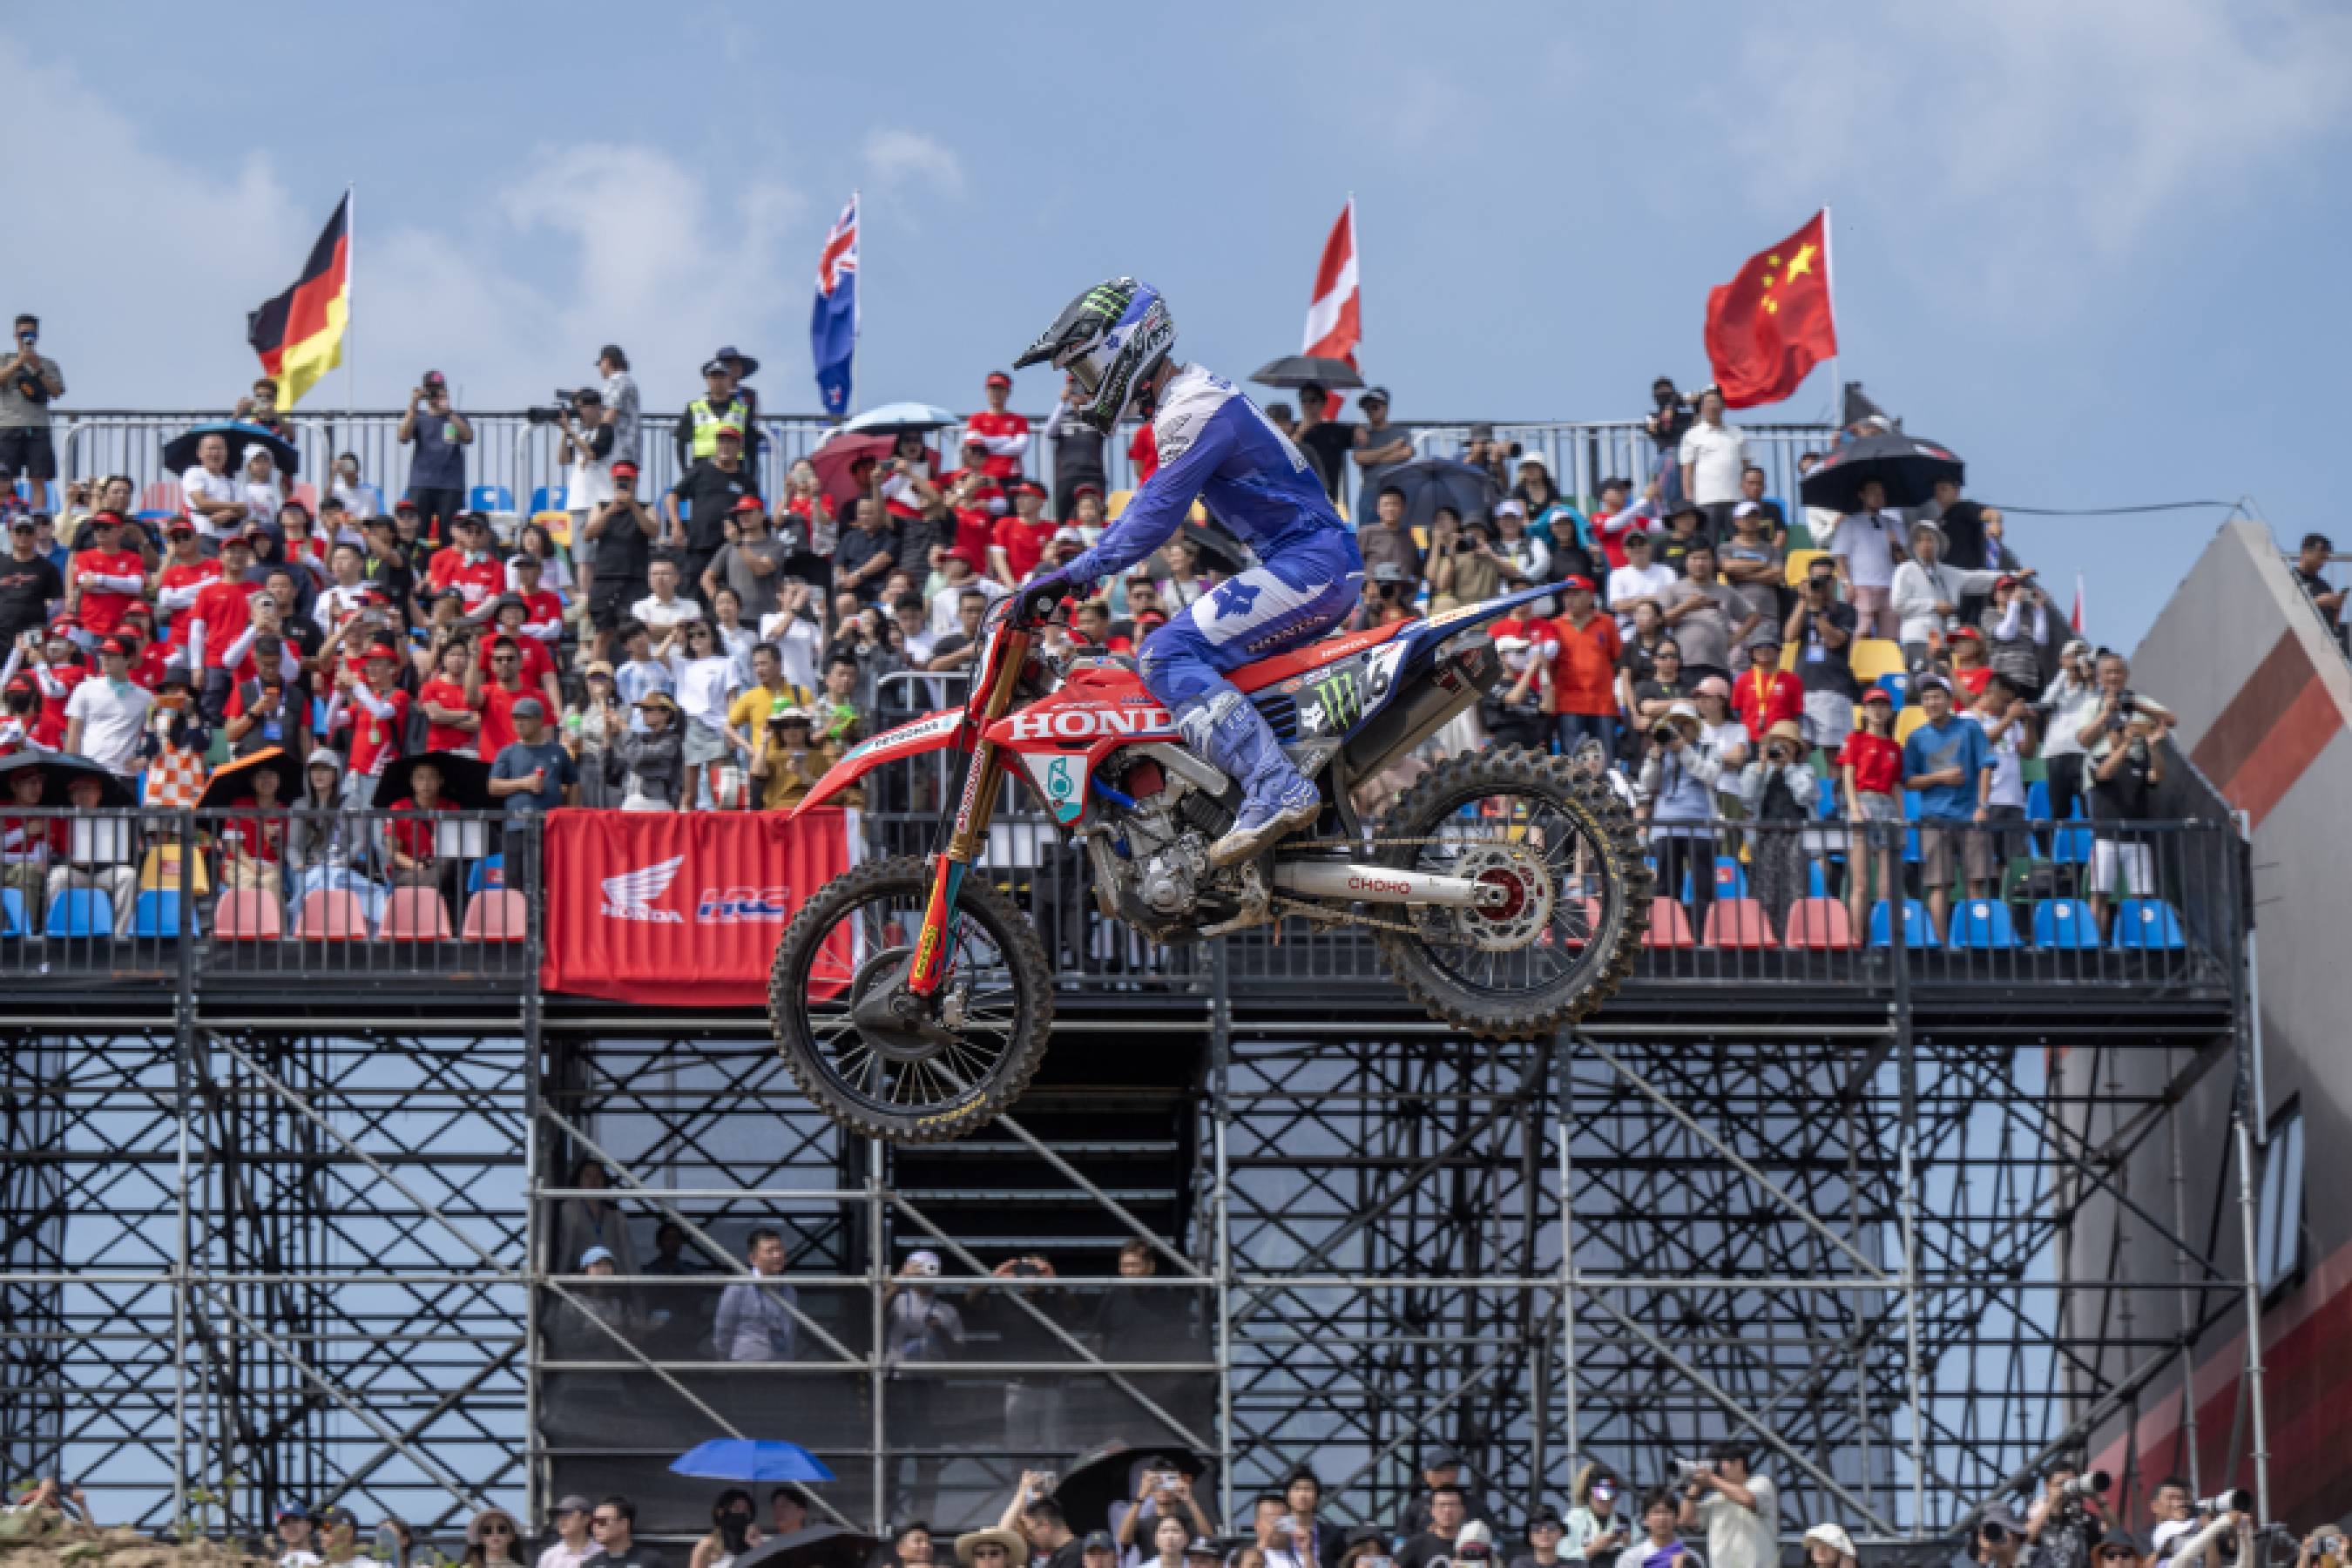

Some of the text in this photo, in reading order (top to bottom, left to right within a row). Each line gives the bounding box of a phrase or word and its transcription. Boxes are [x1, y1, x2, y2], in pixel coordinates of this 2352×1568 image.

[1009, 708, 1179, 740] HOND
[601, 902, 684, 923] HONDA
[696, 886, 790, 923] HRC
